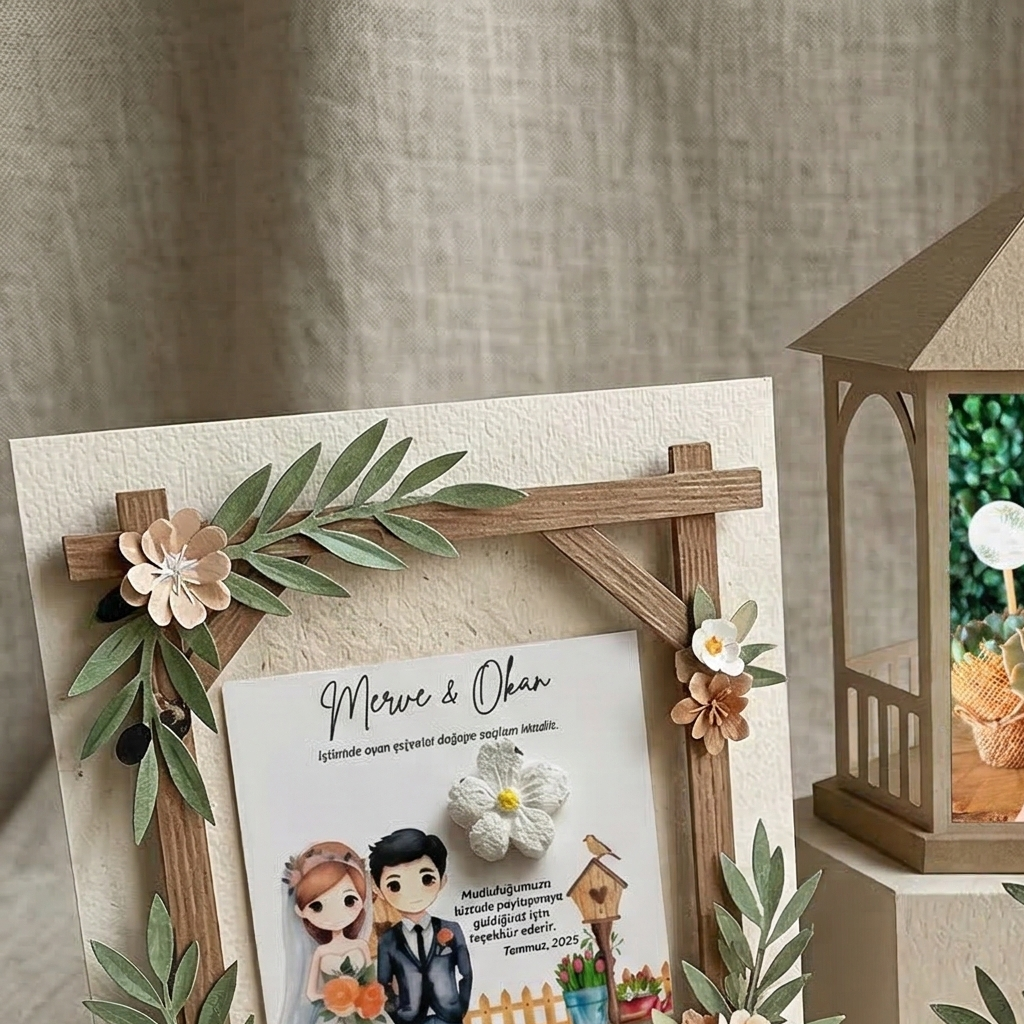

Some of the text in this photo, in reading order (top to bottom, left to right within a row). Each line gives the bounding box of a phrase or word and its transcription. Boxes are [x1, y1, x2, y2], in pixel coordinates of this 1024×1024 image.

[320, 655, 551, 741] Merve & Okan
[551, 934, 580, 949] 2025
